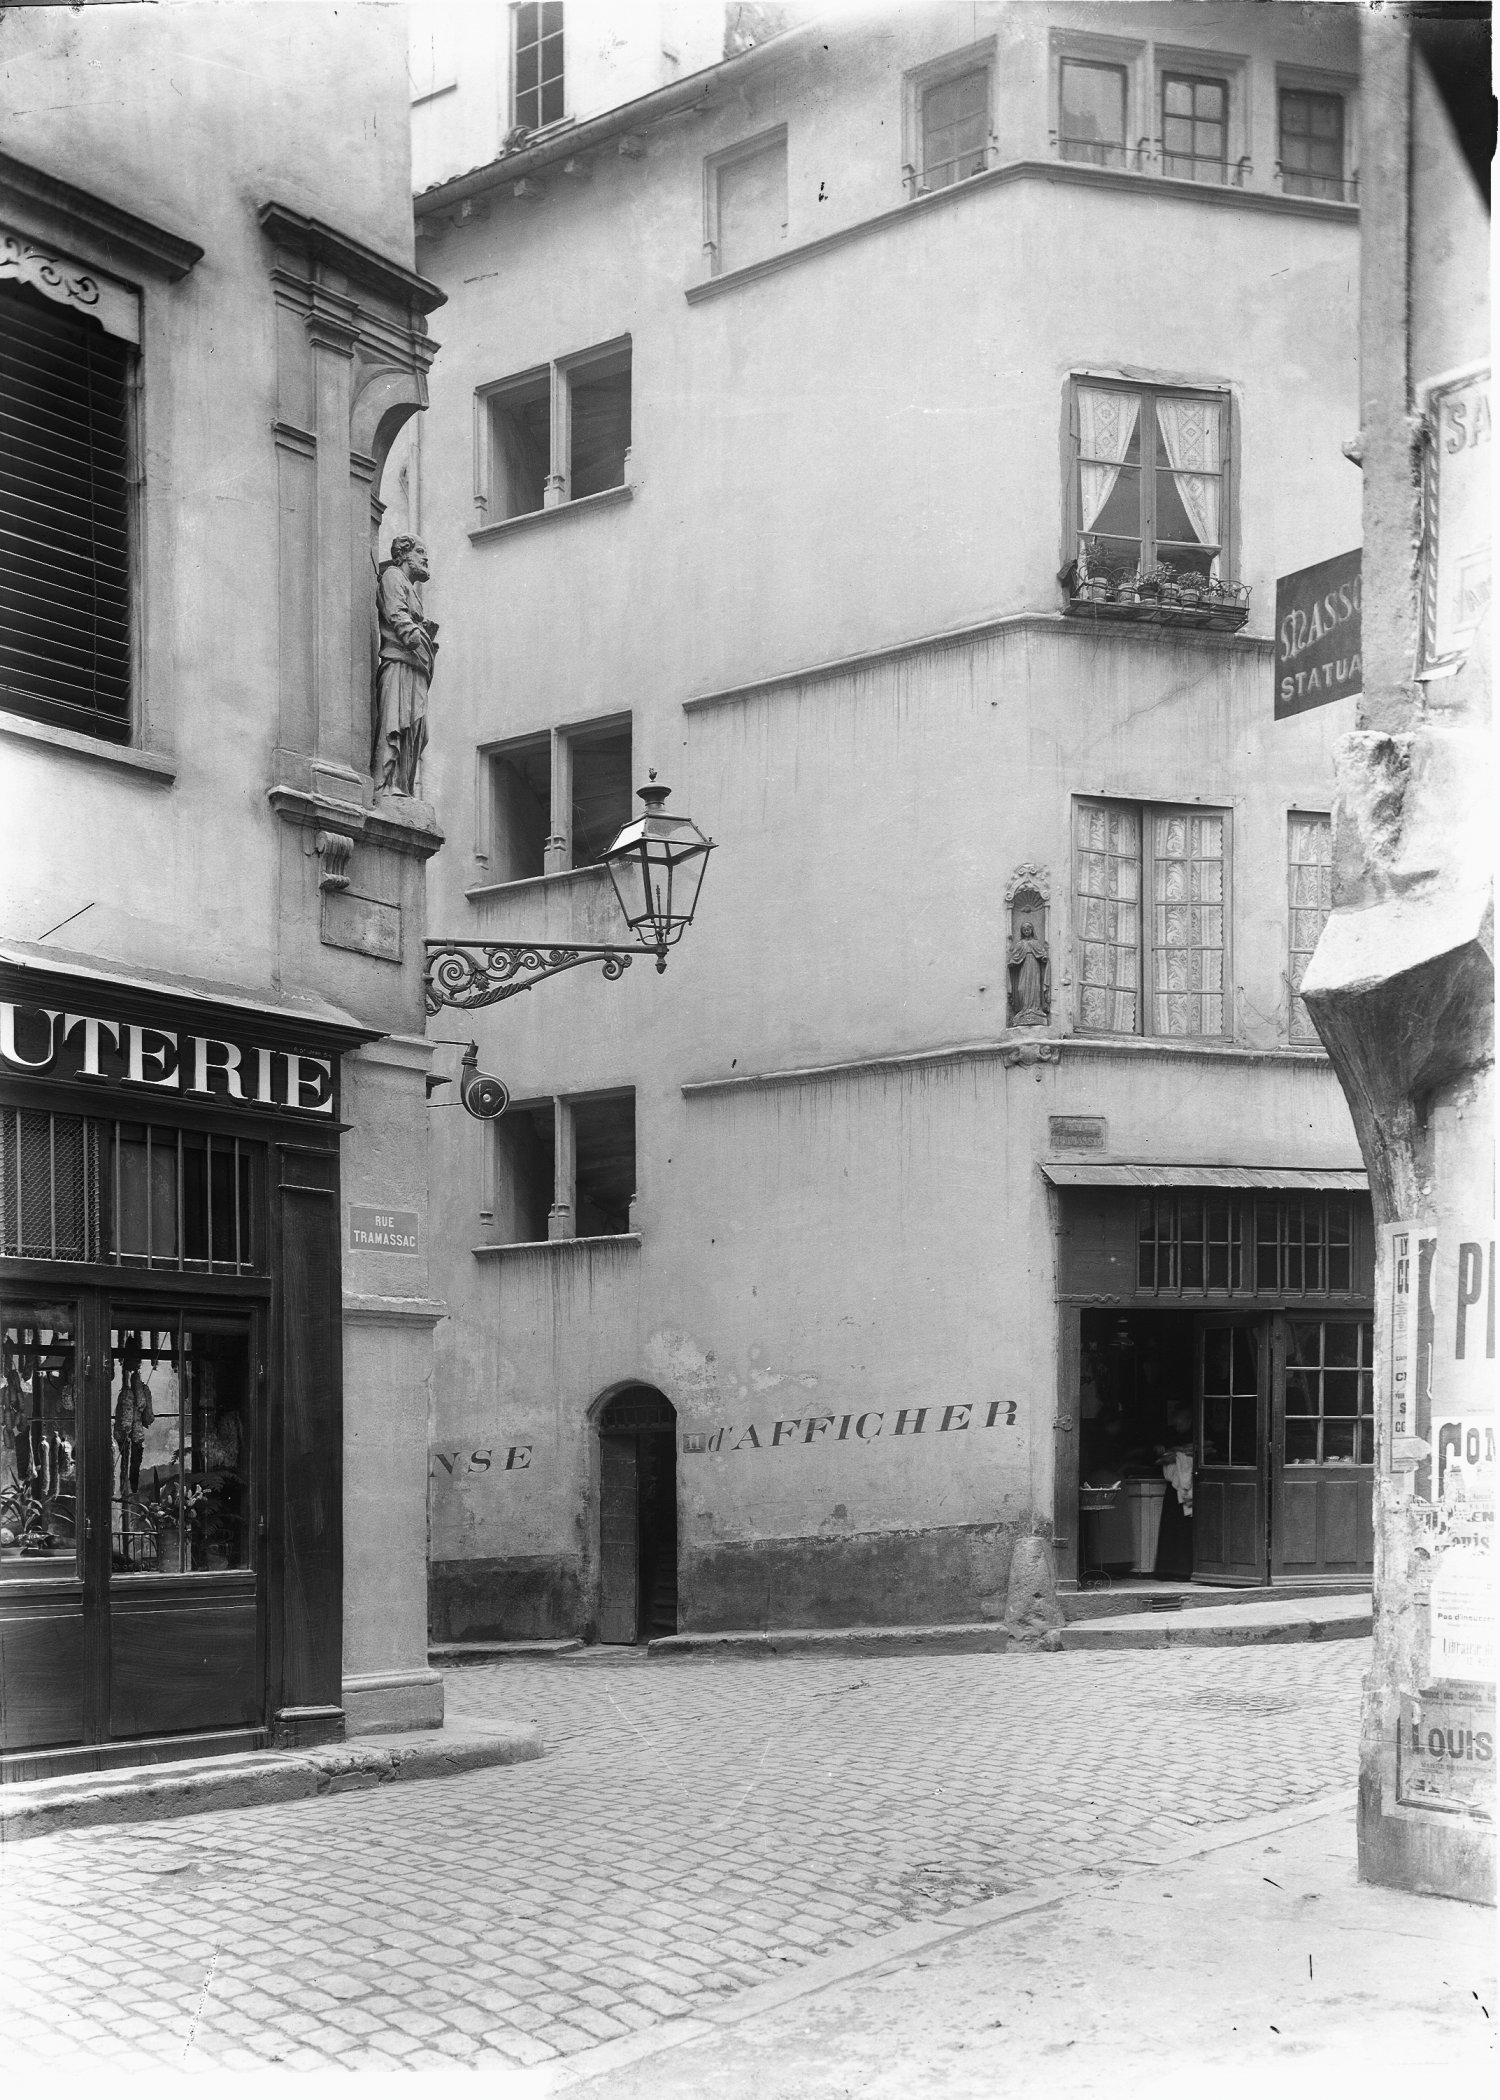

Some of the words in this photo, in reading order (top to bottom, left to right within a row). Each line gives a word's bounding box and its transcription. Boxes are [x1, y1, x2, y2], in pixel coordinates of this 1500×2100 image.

[1281, 654, 1362, 701] STATUA
[375, 1215, 395, 1228] RUE
[353, 1230, 416, 1247] TRAMASSAC
[708, 1399, 1018, 1453] d'AFFICHER
[428, 1445, 534, 1478] NSE
[1437, 1612, 1453, 1621] Pas
[1412, 1723, 1493, 1761] LOUIS
